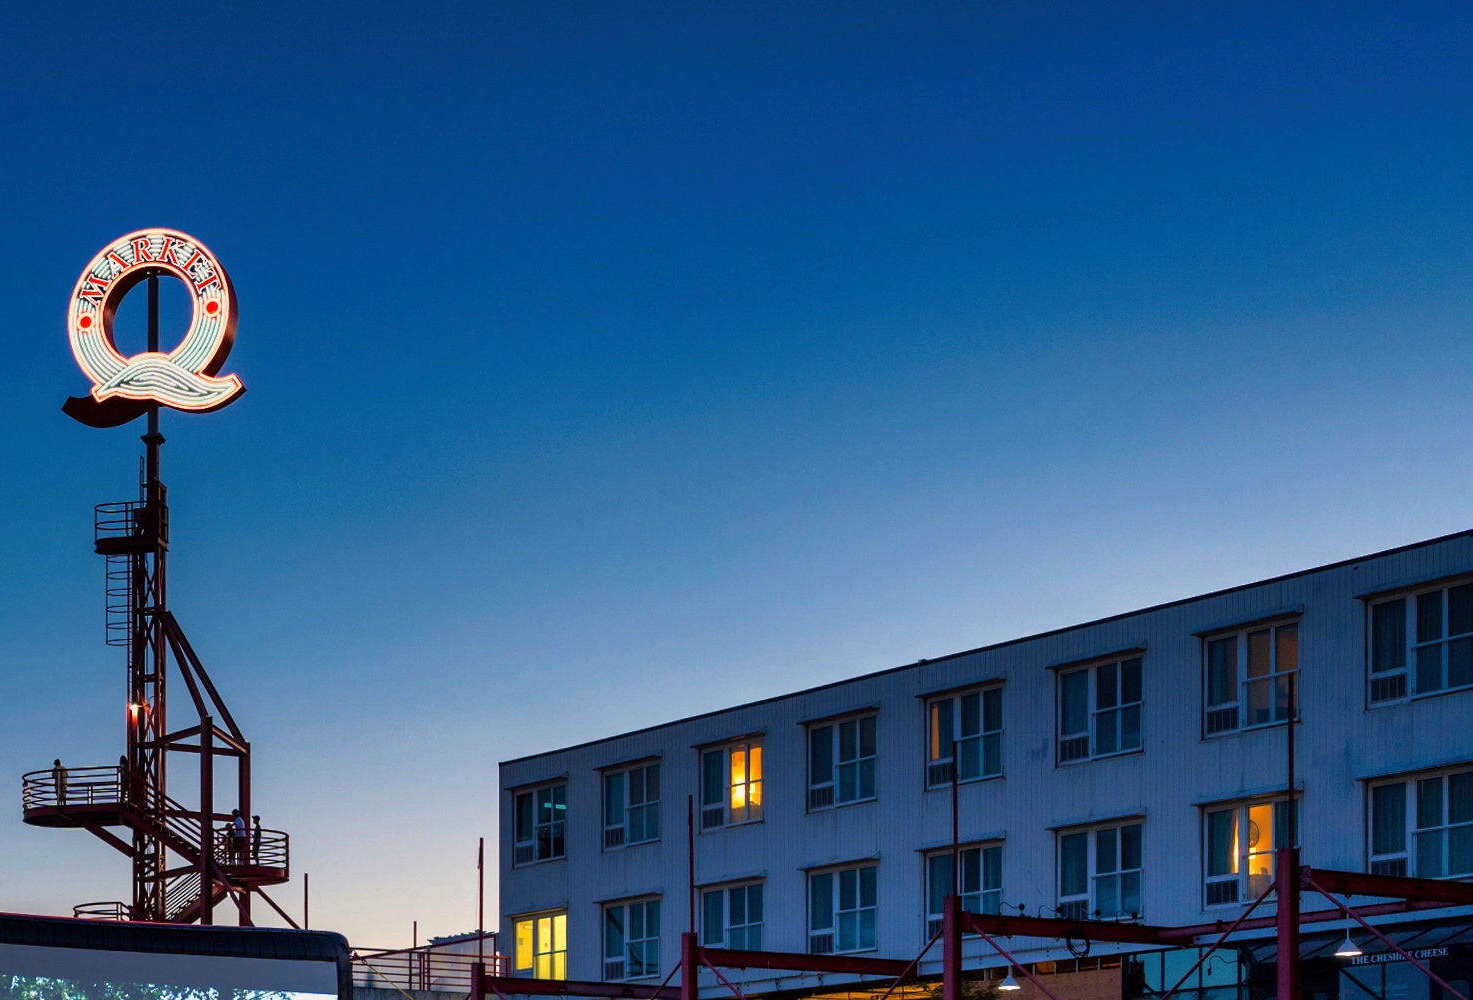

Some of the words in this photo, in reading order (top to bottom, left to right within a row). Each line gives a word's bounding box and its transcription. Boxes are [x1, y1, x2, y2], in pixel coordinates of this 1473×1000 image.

[79, 236, 222, 308] MARKET
[1351, 956, 1369, 965] THE
[1415, 947, 1449, 959] CHEESE
